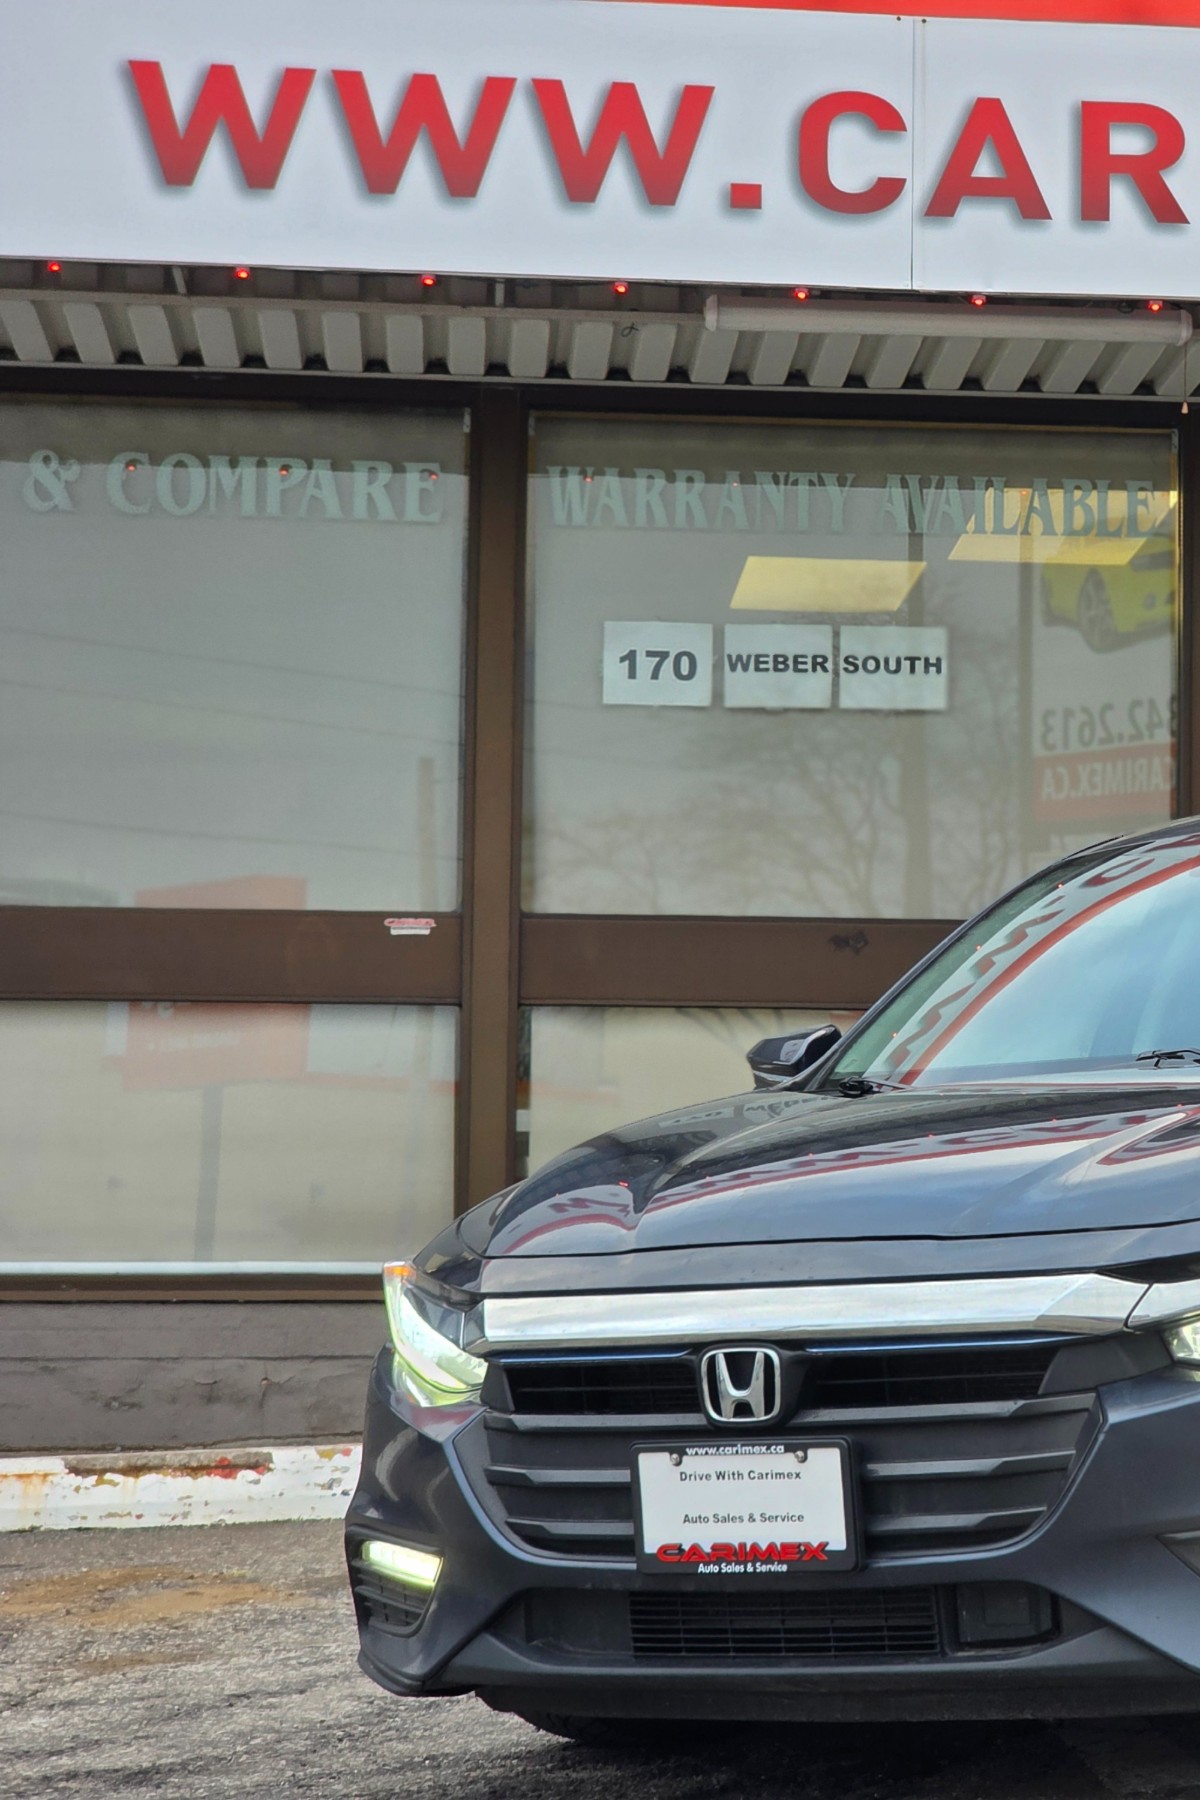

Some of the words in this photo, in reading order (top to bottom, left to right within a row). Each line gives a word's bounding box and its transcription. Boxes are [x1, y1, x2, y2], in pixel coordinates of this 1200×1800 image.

[24, 450, 80, 513] &
[106, 452, 447, 523] COMPARE
[546, 465, 856, 535] WARRANTY
[880, 473, 1163, 539] AVAILABLE
[618, 649, 697, 681] 170
[727, 654, 829, 674] WEBER
[842, 655, 943, 675] SOUTH
[685, 1444, 785, 1456] www.carimex.ca
[679, 1471, 712, 1482] Drive
[715, 1470, 744, 1481] With
[747, 1470, 802, 1481] Carimex
[683, 1513, 710, 1524] Auto
[712, 1512, 744, 1524] Sales
[747, 1512, 757, 1523] &
[759, 1512, 805, 1523] Service
[656, 1541, 829, 1563] CARIMEX
[698, 1563, 719, 1574] Auto
[721, 1563, 744, 1574] Sales
[746, 1563, 754, 1573] &
[756, 1562, 788, 1573] Service
